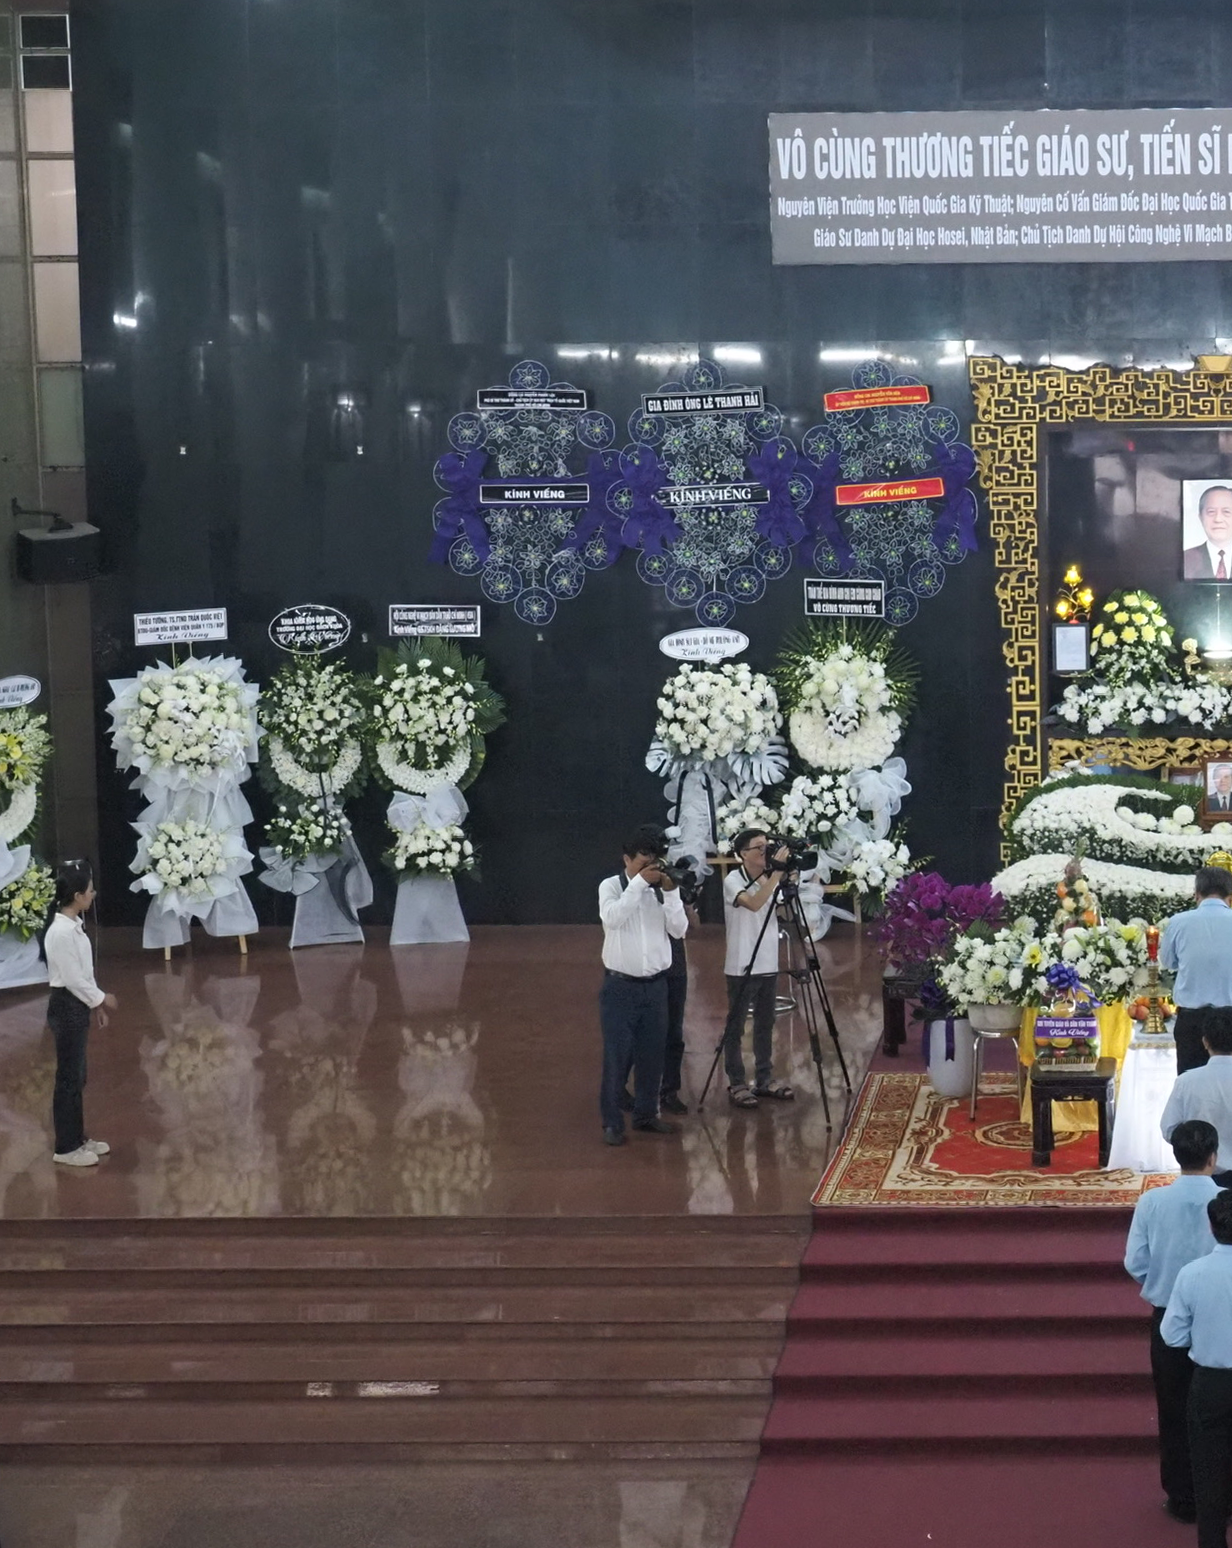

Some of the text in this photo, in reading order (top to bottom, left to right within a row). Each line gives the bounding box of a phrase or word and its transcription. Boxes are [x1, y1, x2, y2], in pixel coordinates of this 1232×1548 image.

[777, 128, 806, 179] VÔ
[814, 128, 876, 179] CÙNG
[883, 132, 973, 178] THƯƠNG
[980, 121, 1029, 177] TIẾC
[1036, 125, 1089, 176] GIÁO
[1096, 130, 1134, 180] SƯ,
[1140, 119, 1191, 175] TIẾN
[1198, 125, 1221, 175] SĨ
[778, 197, 815, 218] Nguyên
[817, 196, 839, 219] Viện
[841, 194, 875, 217] Trưởng
[877, 196, 896, 219] Học
[899, 195, 920, 218] Viện
[922, 192, 948, 216] Quốc
[950, 195, 967, 214] Gia
[969, 194, 981, 216] Kỹ
[984, 194, 1014, 217] Thuật;
[1016, 193, 1054, 215] Nguyên
[1056, 190, 1070, 212] Cố
[1071, 189, 1090, 212] Vấn
[1092, 192, 1118, 211] Giám
[1120, 189, 1140, 212] Đốc
[1142, 192, 1158, 215] Đại
[1161, 192, 1180, 215] Học
[1182, 189, 1208, 213] Quốc
[1210, 191, 1226, 211] Gia
[814, 228, 836, 247] Giáo
[839, 228, 852, 247] Sư
[854, 228, 879, 246] Danh
[881, 228, 895, 250] Dự
[897, 227, 914, 250] Đại
[916, 227, 935, 250] Học
[938, 227, 968, 248] Hosei,
[971, 226, 994, 249] Nhật
[996, 224, 1018, 247] Bản;
[1021, 223, 1040, 244] Chủ
[1042, 226, 1064, 248] Tịch
[1066, 225, 1091, 244] Danh
[1093, 225, 1107, 247] Dự
[1109, 225, 1126, 247] Hội
[1128, 224, 1153, 245] Công
[1155, 224, 1181, 246] Nghệ
[1183, 224, 1193, 242] Vi
[1195, 224, 1223, 246] Mạch
[504, 487, 565, 499] KÍNH VIẾNG
[709, 486, 752, 500] VIẾNG
[889, 485, 917, 496] VIẾNG
